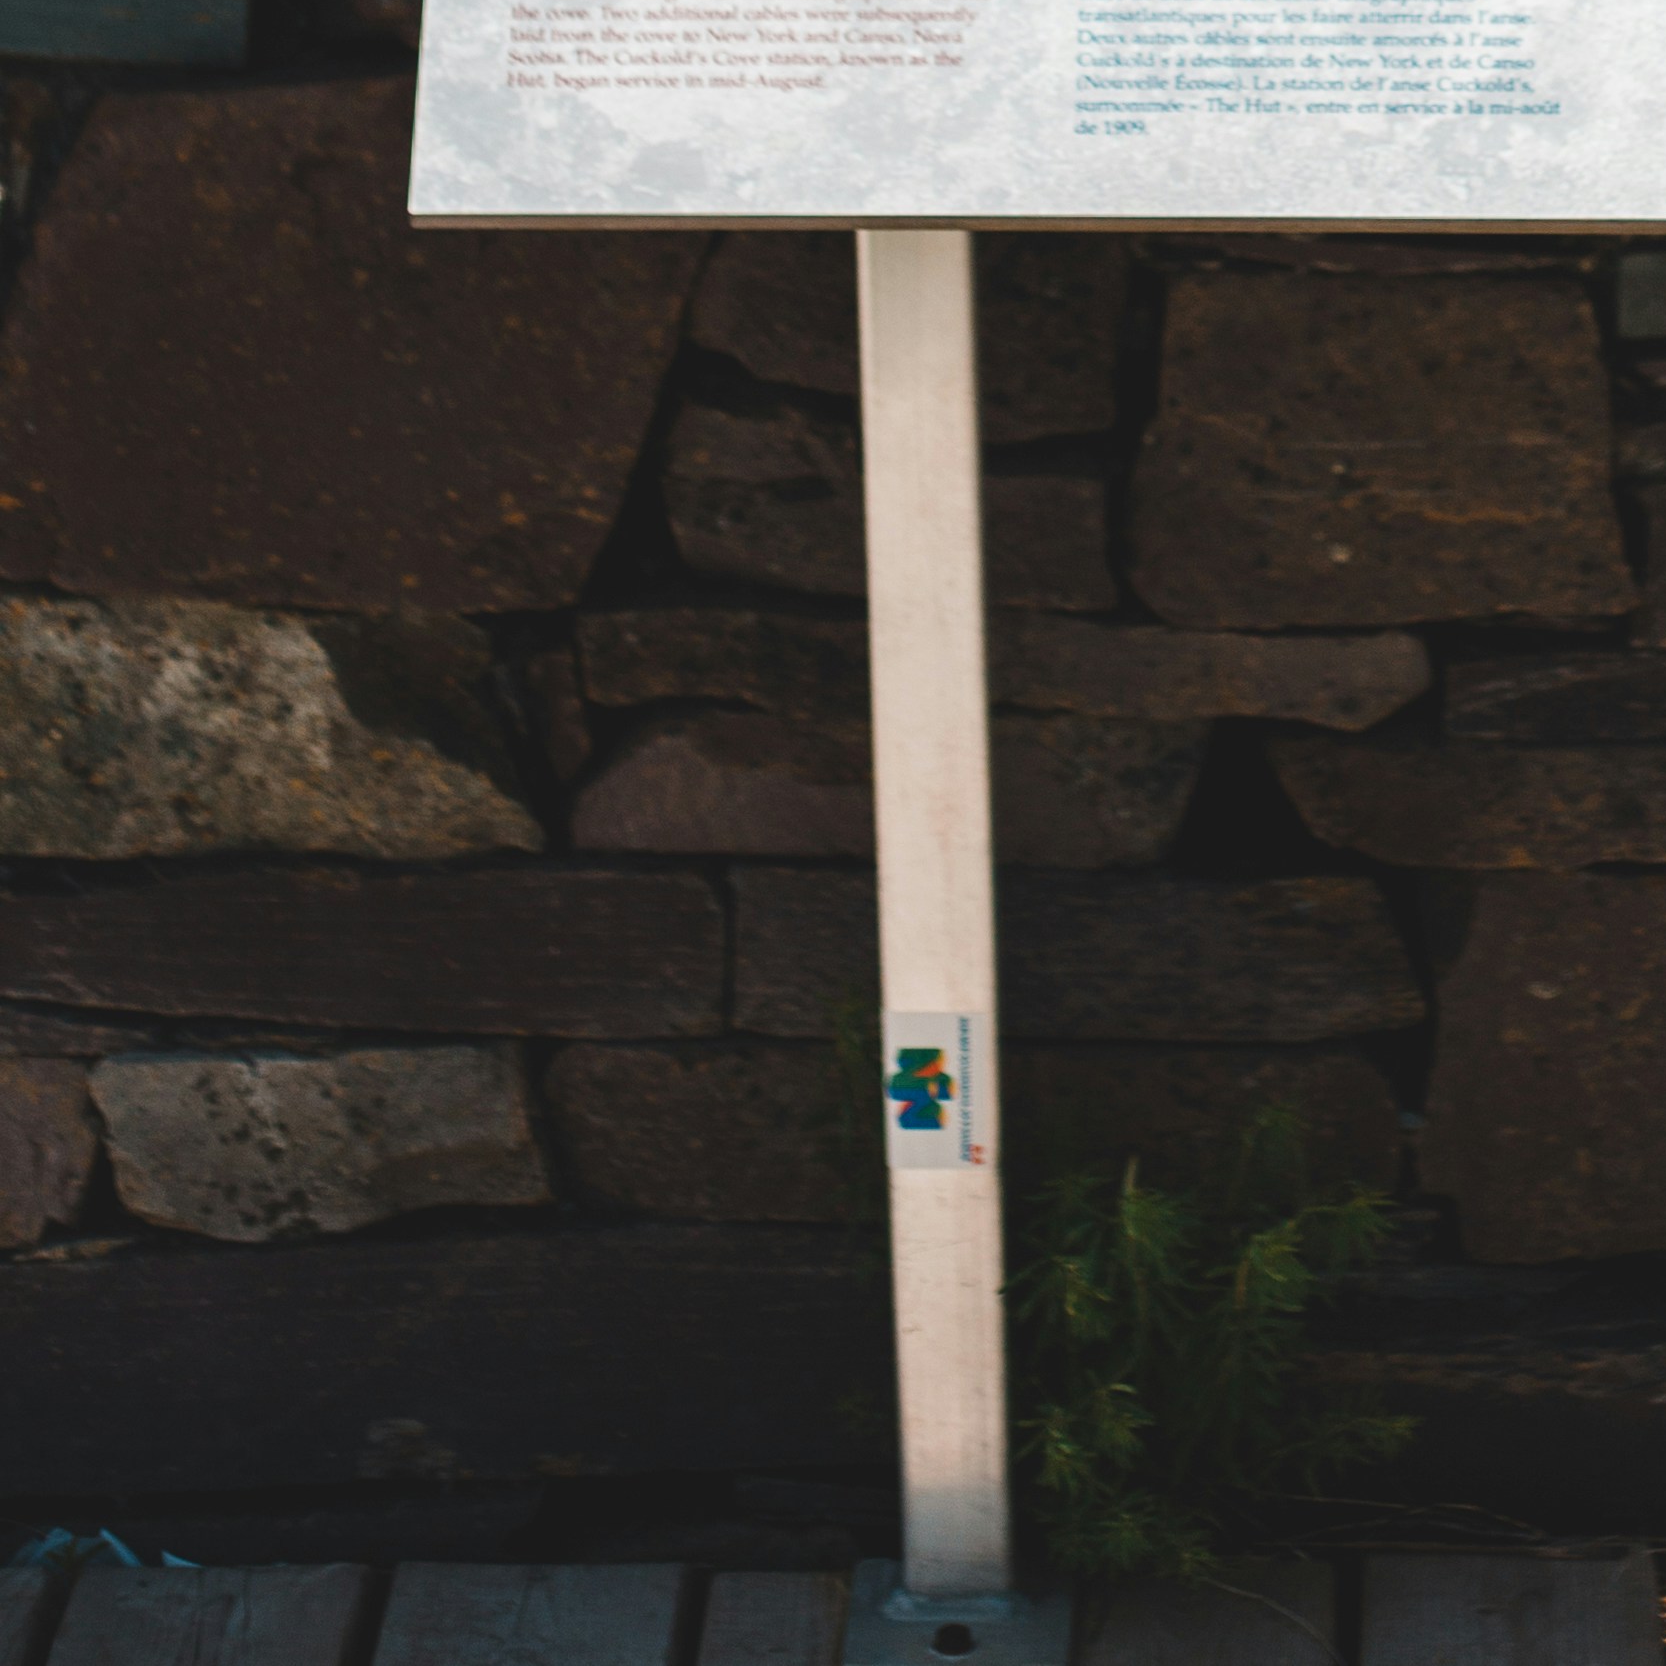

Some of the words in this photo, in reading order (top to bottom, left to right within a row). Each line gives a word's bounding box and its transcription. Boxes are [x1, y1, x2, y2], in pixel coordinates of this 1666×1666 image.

[1077, 6, 1227, 27] transatlantiques
[1231, 12, 1277, 27] pour
[1311, 7, 1354, 24] faire
[1358, 7, 1424, 24] atterrir
[1428, 7, 1473, 24] dans
[1075, 51, 1170, 68] Cuckold's
[1190, 51, 1296, 68] destination
[1377, 52, 1422, 68] York
[1476, 52, 1536, 69] Canso
[1075, 73, 1170, 92] (Nouvelle
[1280, 74, 1345, 91] station
[1376, 75, 1432, 91] l'anse
